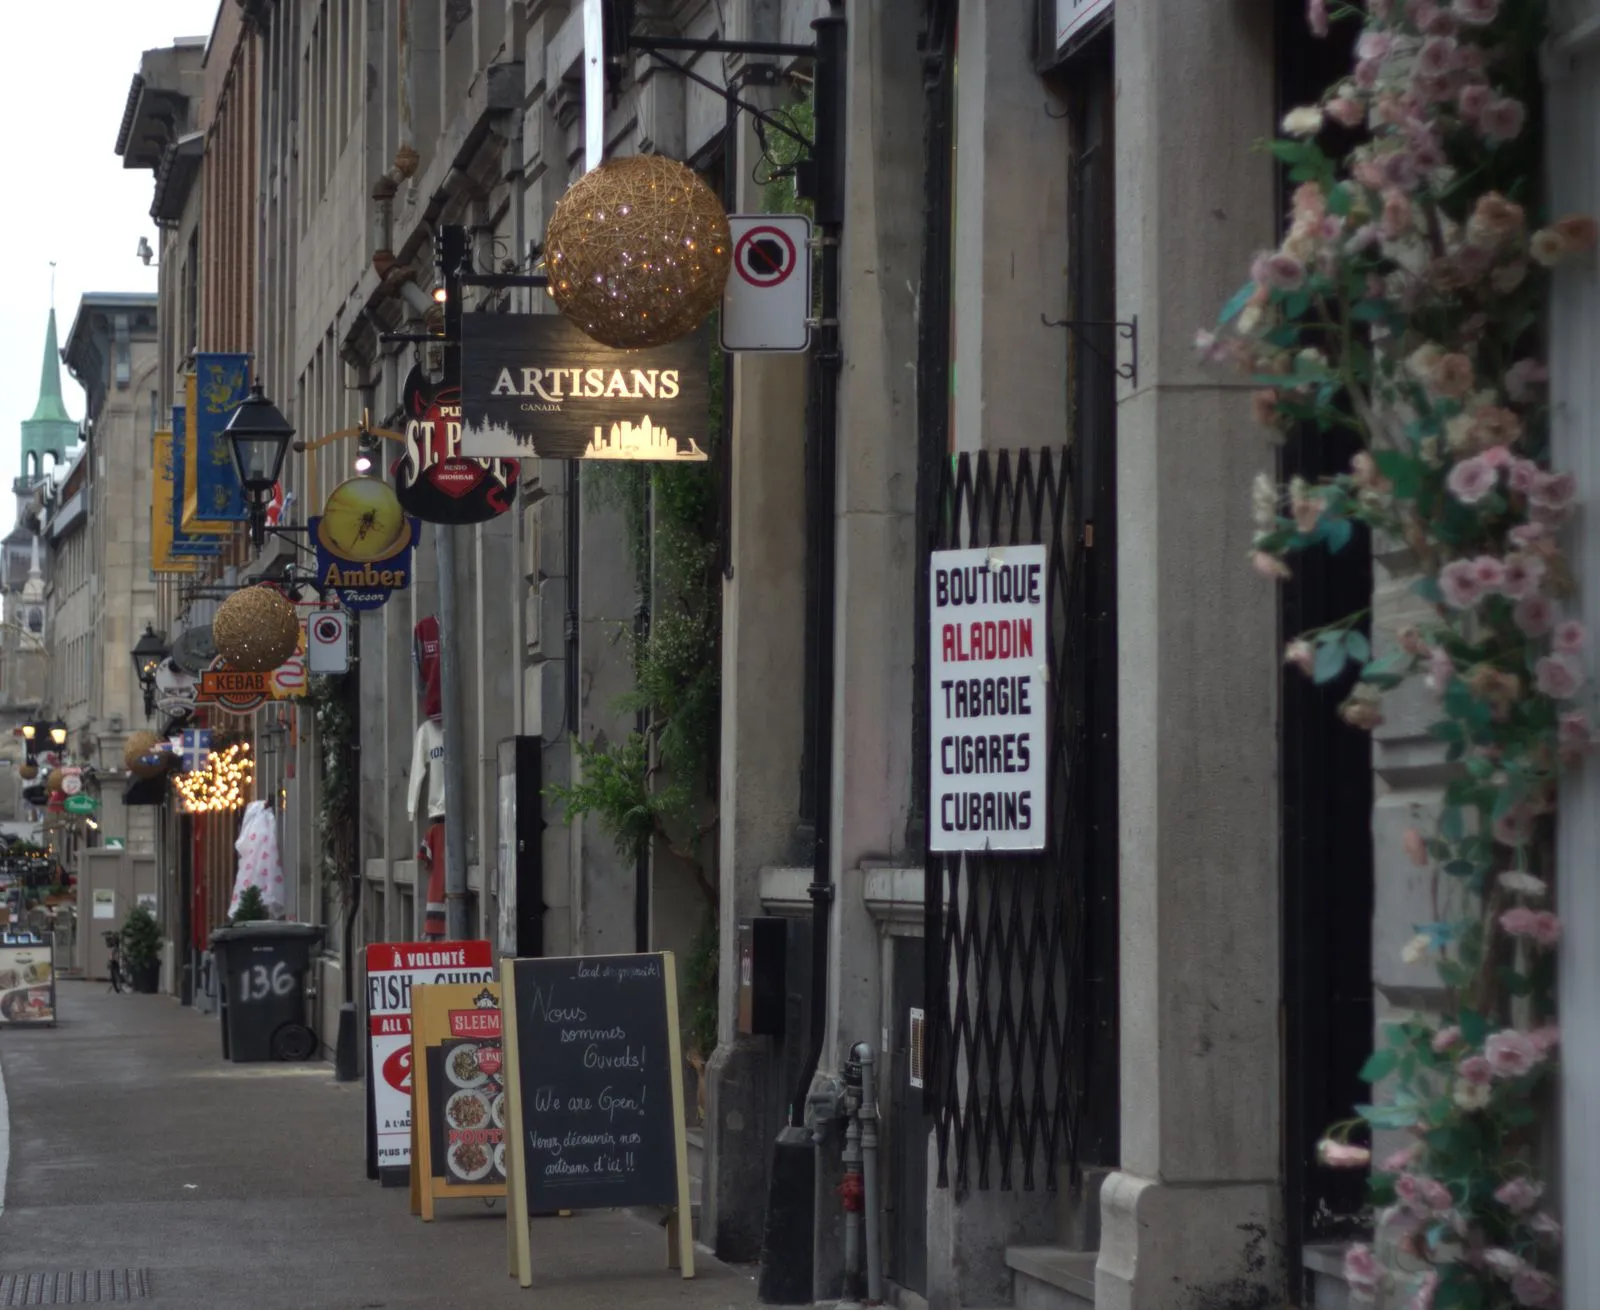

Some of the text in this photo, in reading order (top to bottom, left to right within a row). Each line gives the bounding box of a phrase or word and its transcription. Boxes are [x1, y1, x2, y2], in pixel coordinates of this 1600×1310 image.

[491, 367, 679, 401] ARTISANS
[440, 406, 462, 417] PU
[520, 403, 561, 412] CANADA
[406, 420, 439, 489] ST.
[324, 562, 405, 587] Amber
[936, 564, 1041, 607] BOUTIQUE
[942, 618, 1033, 662] ALADDIN
[216, 674, 264, 691] KEBAB
[941, 676, 1031, 718] TABAGIE
[941, 733, 1030, 775] CIGARES
[941, 791, 1031, 832] CUBAINS
[394, 949, 465, 967] À VOLONTÉ
[241, 961, 294, 1002] 136
[369, 974, 413, 1010] FISH
[531, 985, 587, 1022] Nous
[382, 1018, 402, 1032] ALL
[455, 1015, 503, 1031] SLEEM
[561, 1026, 626, 1043] sommes
[535, 1087, 560, 1112] We
[568, 1096, 592, 1111] are
[379, 1148, 400, 1157] PLUS
[530, 1131, 561, 1156] Venez
[619, 1132, 641, 1144] nos
[545, 1158, 589, 1175] artisans
